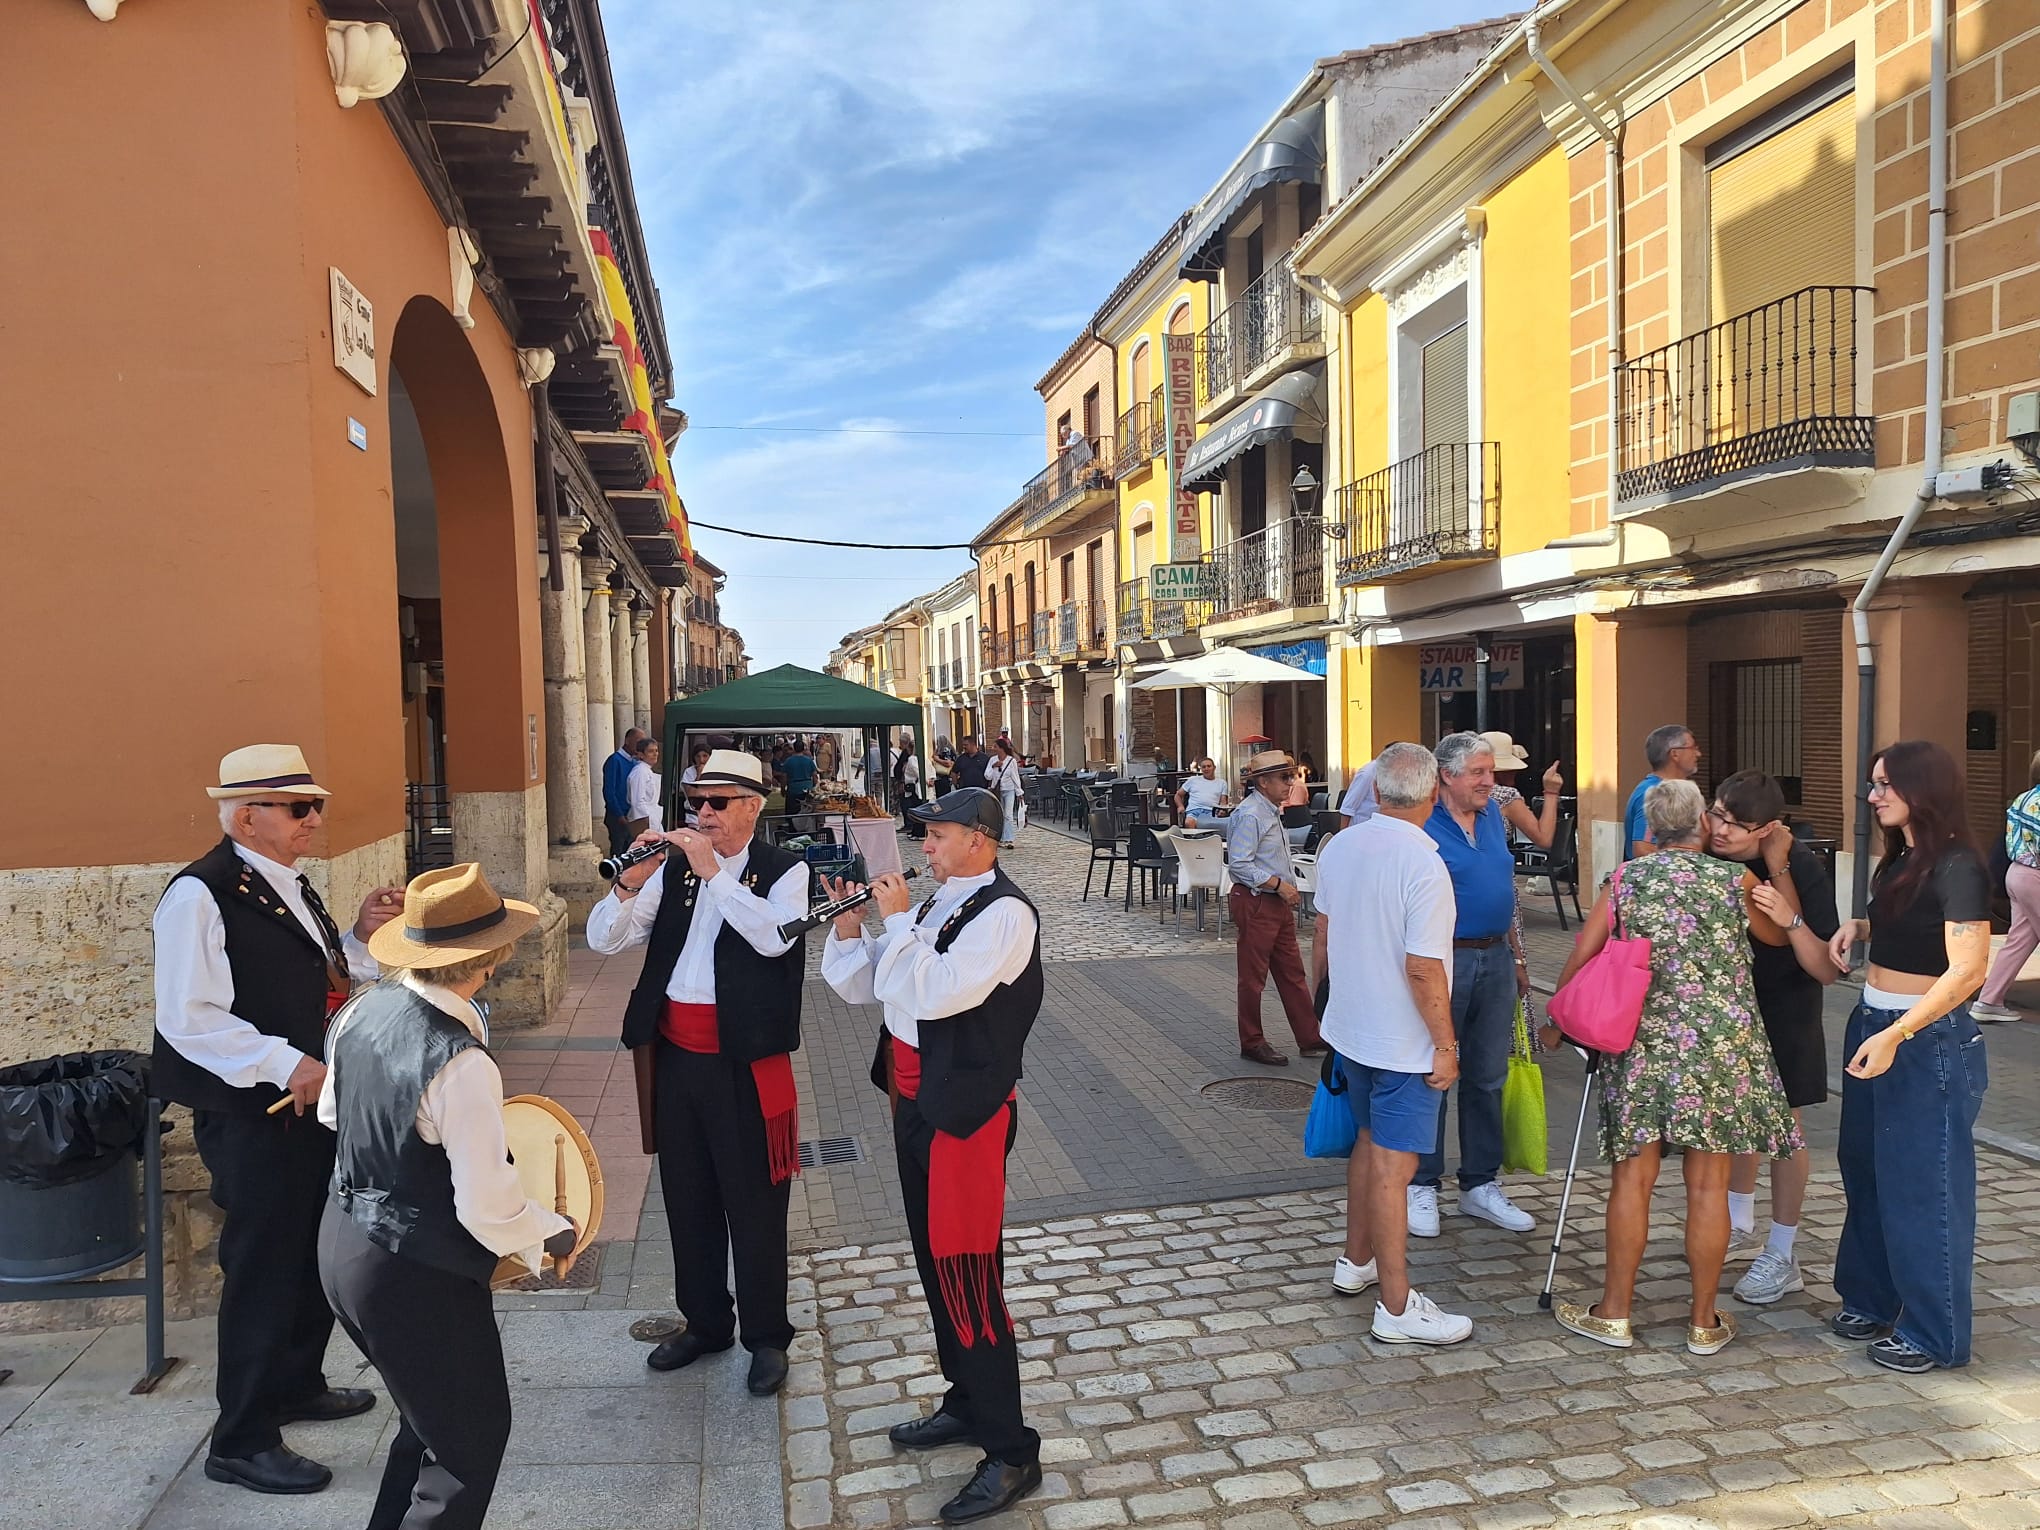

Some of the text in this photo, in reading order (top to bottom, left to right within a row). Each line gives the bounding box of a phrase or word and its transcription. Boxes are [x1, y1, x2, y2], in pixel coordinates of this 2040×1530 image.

[1168, 337, 1193, 352] BAR
[1172, 358, 1196, 534] RESTAURNTE
[1155, 566, 1217, 586] CAMA
[1420, 645, 1521, 665] STAURNTE
